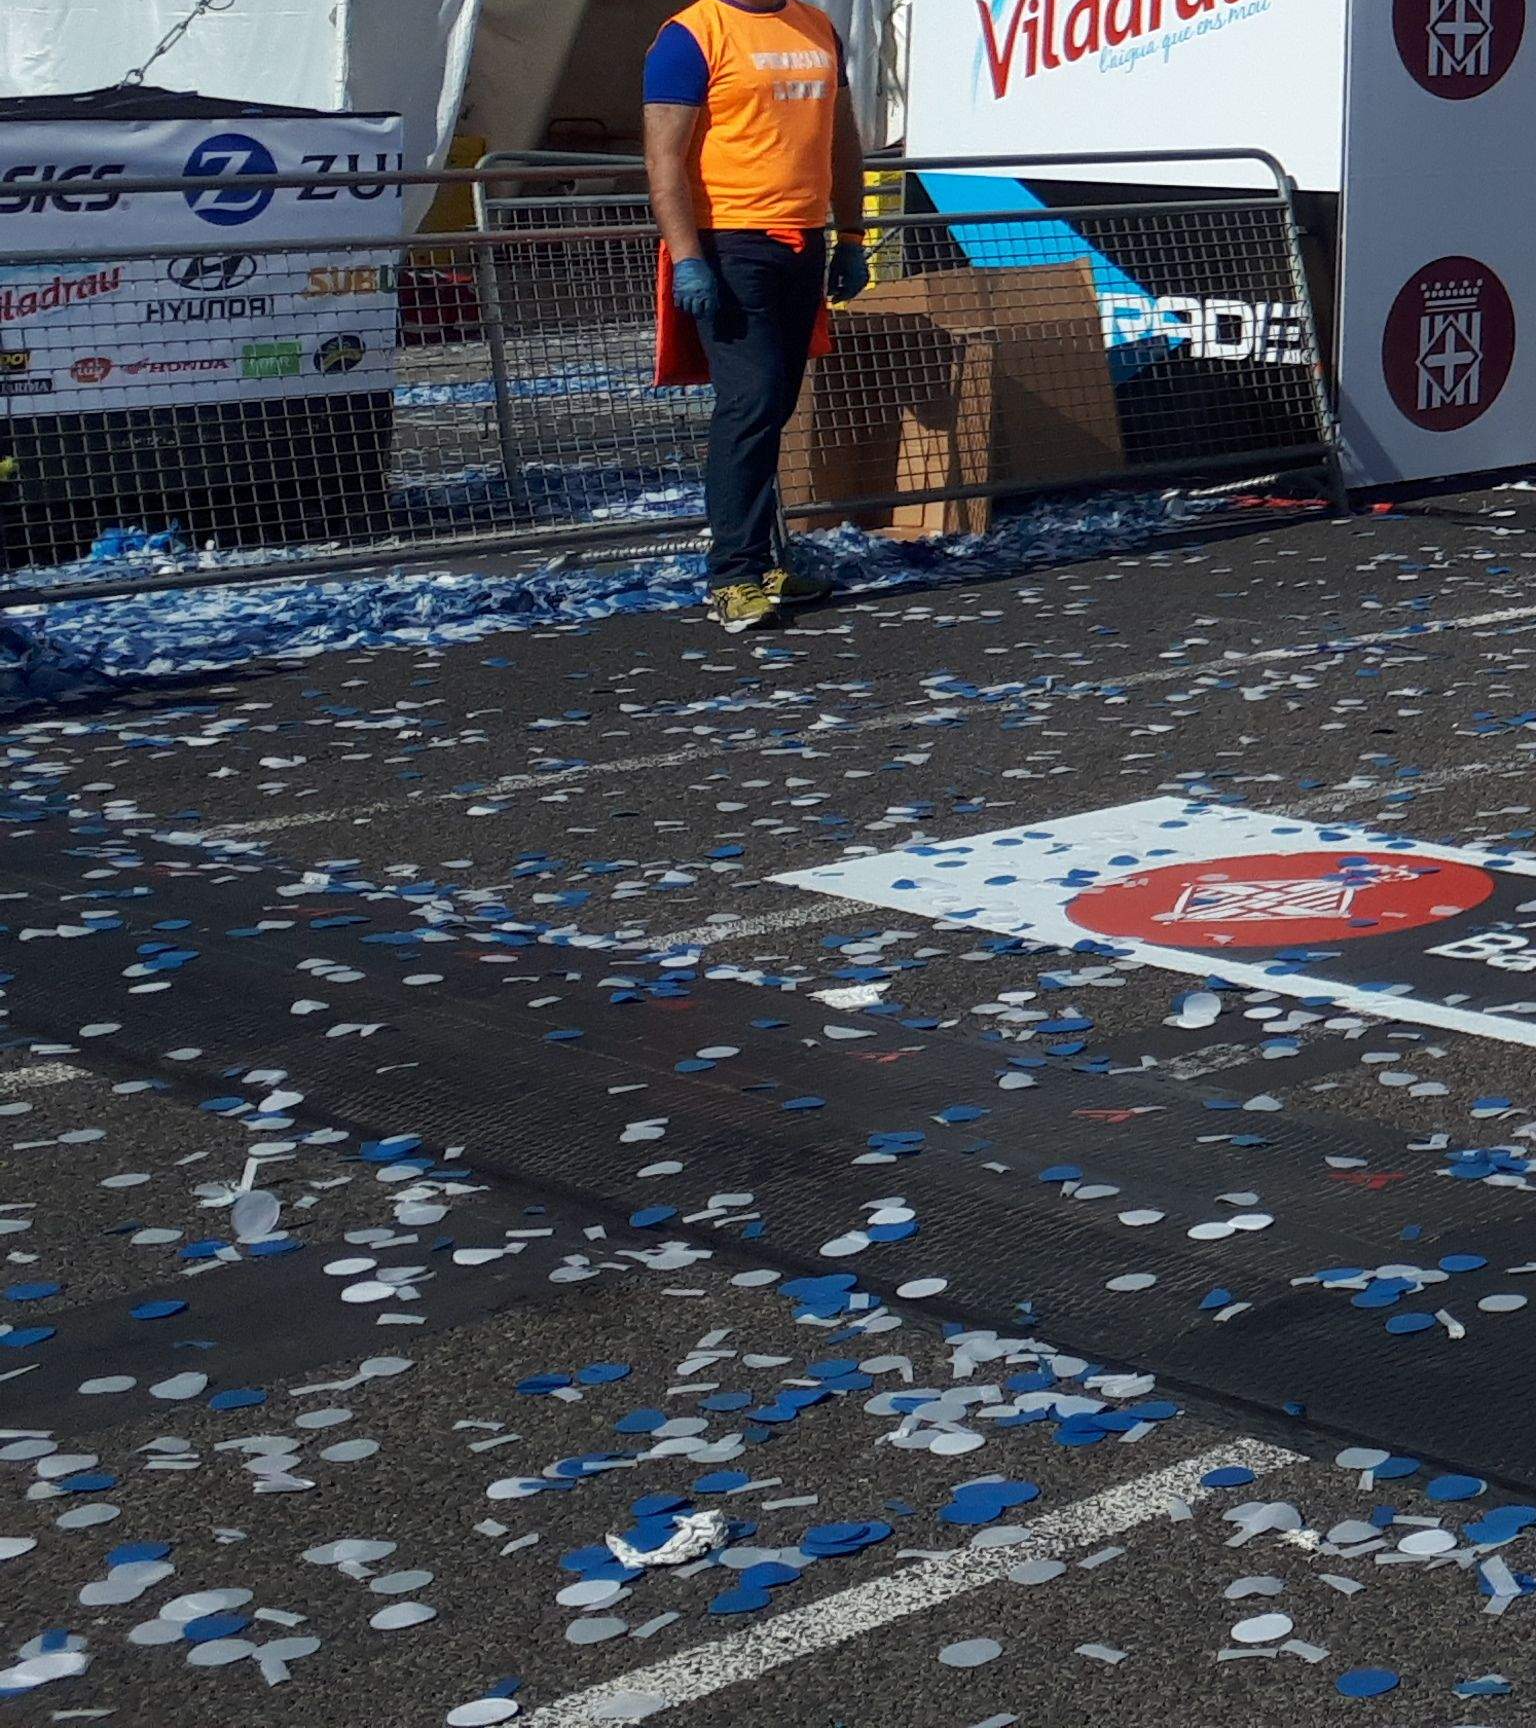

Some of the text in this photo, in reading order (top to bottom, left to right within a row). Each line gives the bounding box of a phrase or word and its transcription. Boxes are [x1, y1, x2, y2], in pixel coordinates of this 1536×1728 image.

[297, 152, 403, 202] ZU
[0, 265, 121, 321] ladrau
[146, 295, 275, 322] HYUNDAI
